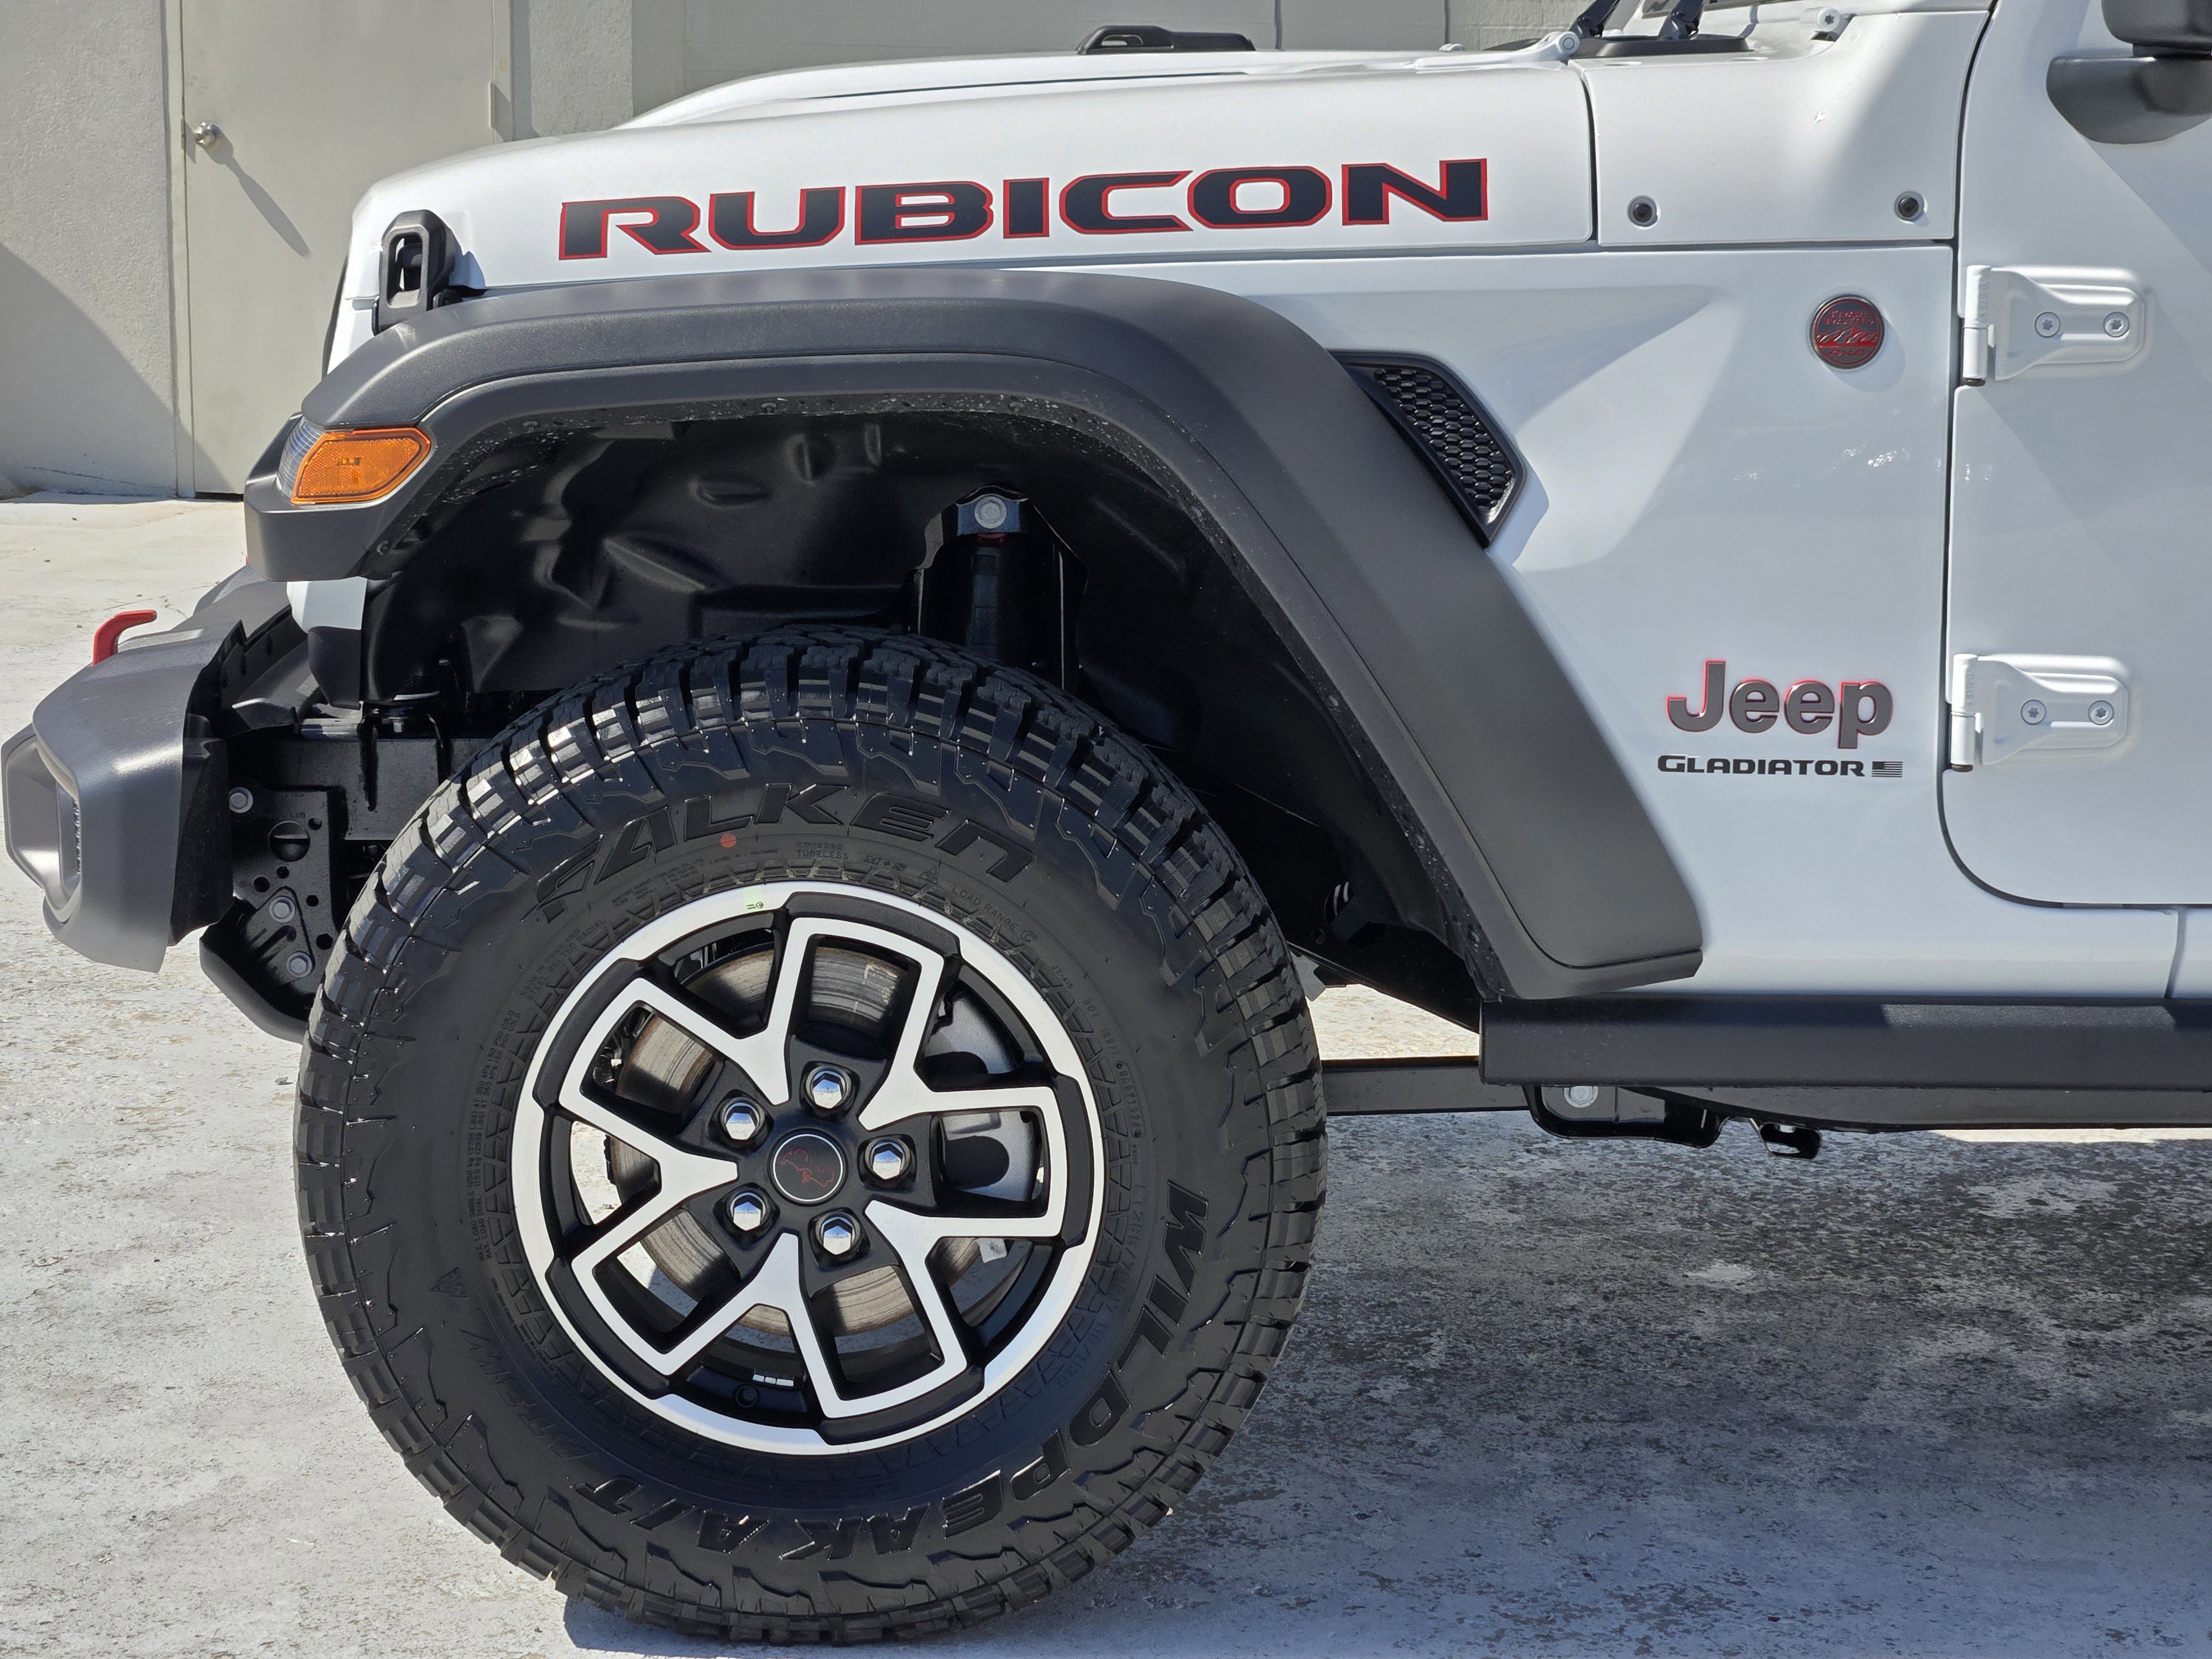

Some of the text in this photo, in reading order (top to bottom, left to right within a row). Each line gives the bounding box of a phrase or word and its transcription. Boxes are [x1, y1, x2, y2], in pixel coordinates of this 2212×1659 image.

[559, 158, 1488, 260] RUBICON
[1666, 659, 1893, 749] Jeep
[1657, 755, 1866, 777] GLADIATOR
[521, 783, 1035, 926] FALKEN
[796, 849, 849, 859] TUBELESS
[951, 884, 983, 906] LOAD
[983, 902, 1019, 931] RANGE
[526, 916, 606, 1001] STEEL BELTED RADIAL
[500, 1009, 515, 1030] COLD
[472, 1098, 481, 1107] AT
[474, 1196, 483, 1216] DUAL
[479, 1099, 487, 1108] AT
[506, 1011, 521, 1032] COLD
[470, 1220, 480, 1241] LOAD
[778, 1182, 1209, 1562] WILDPEAK
